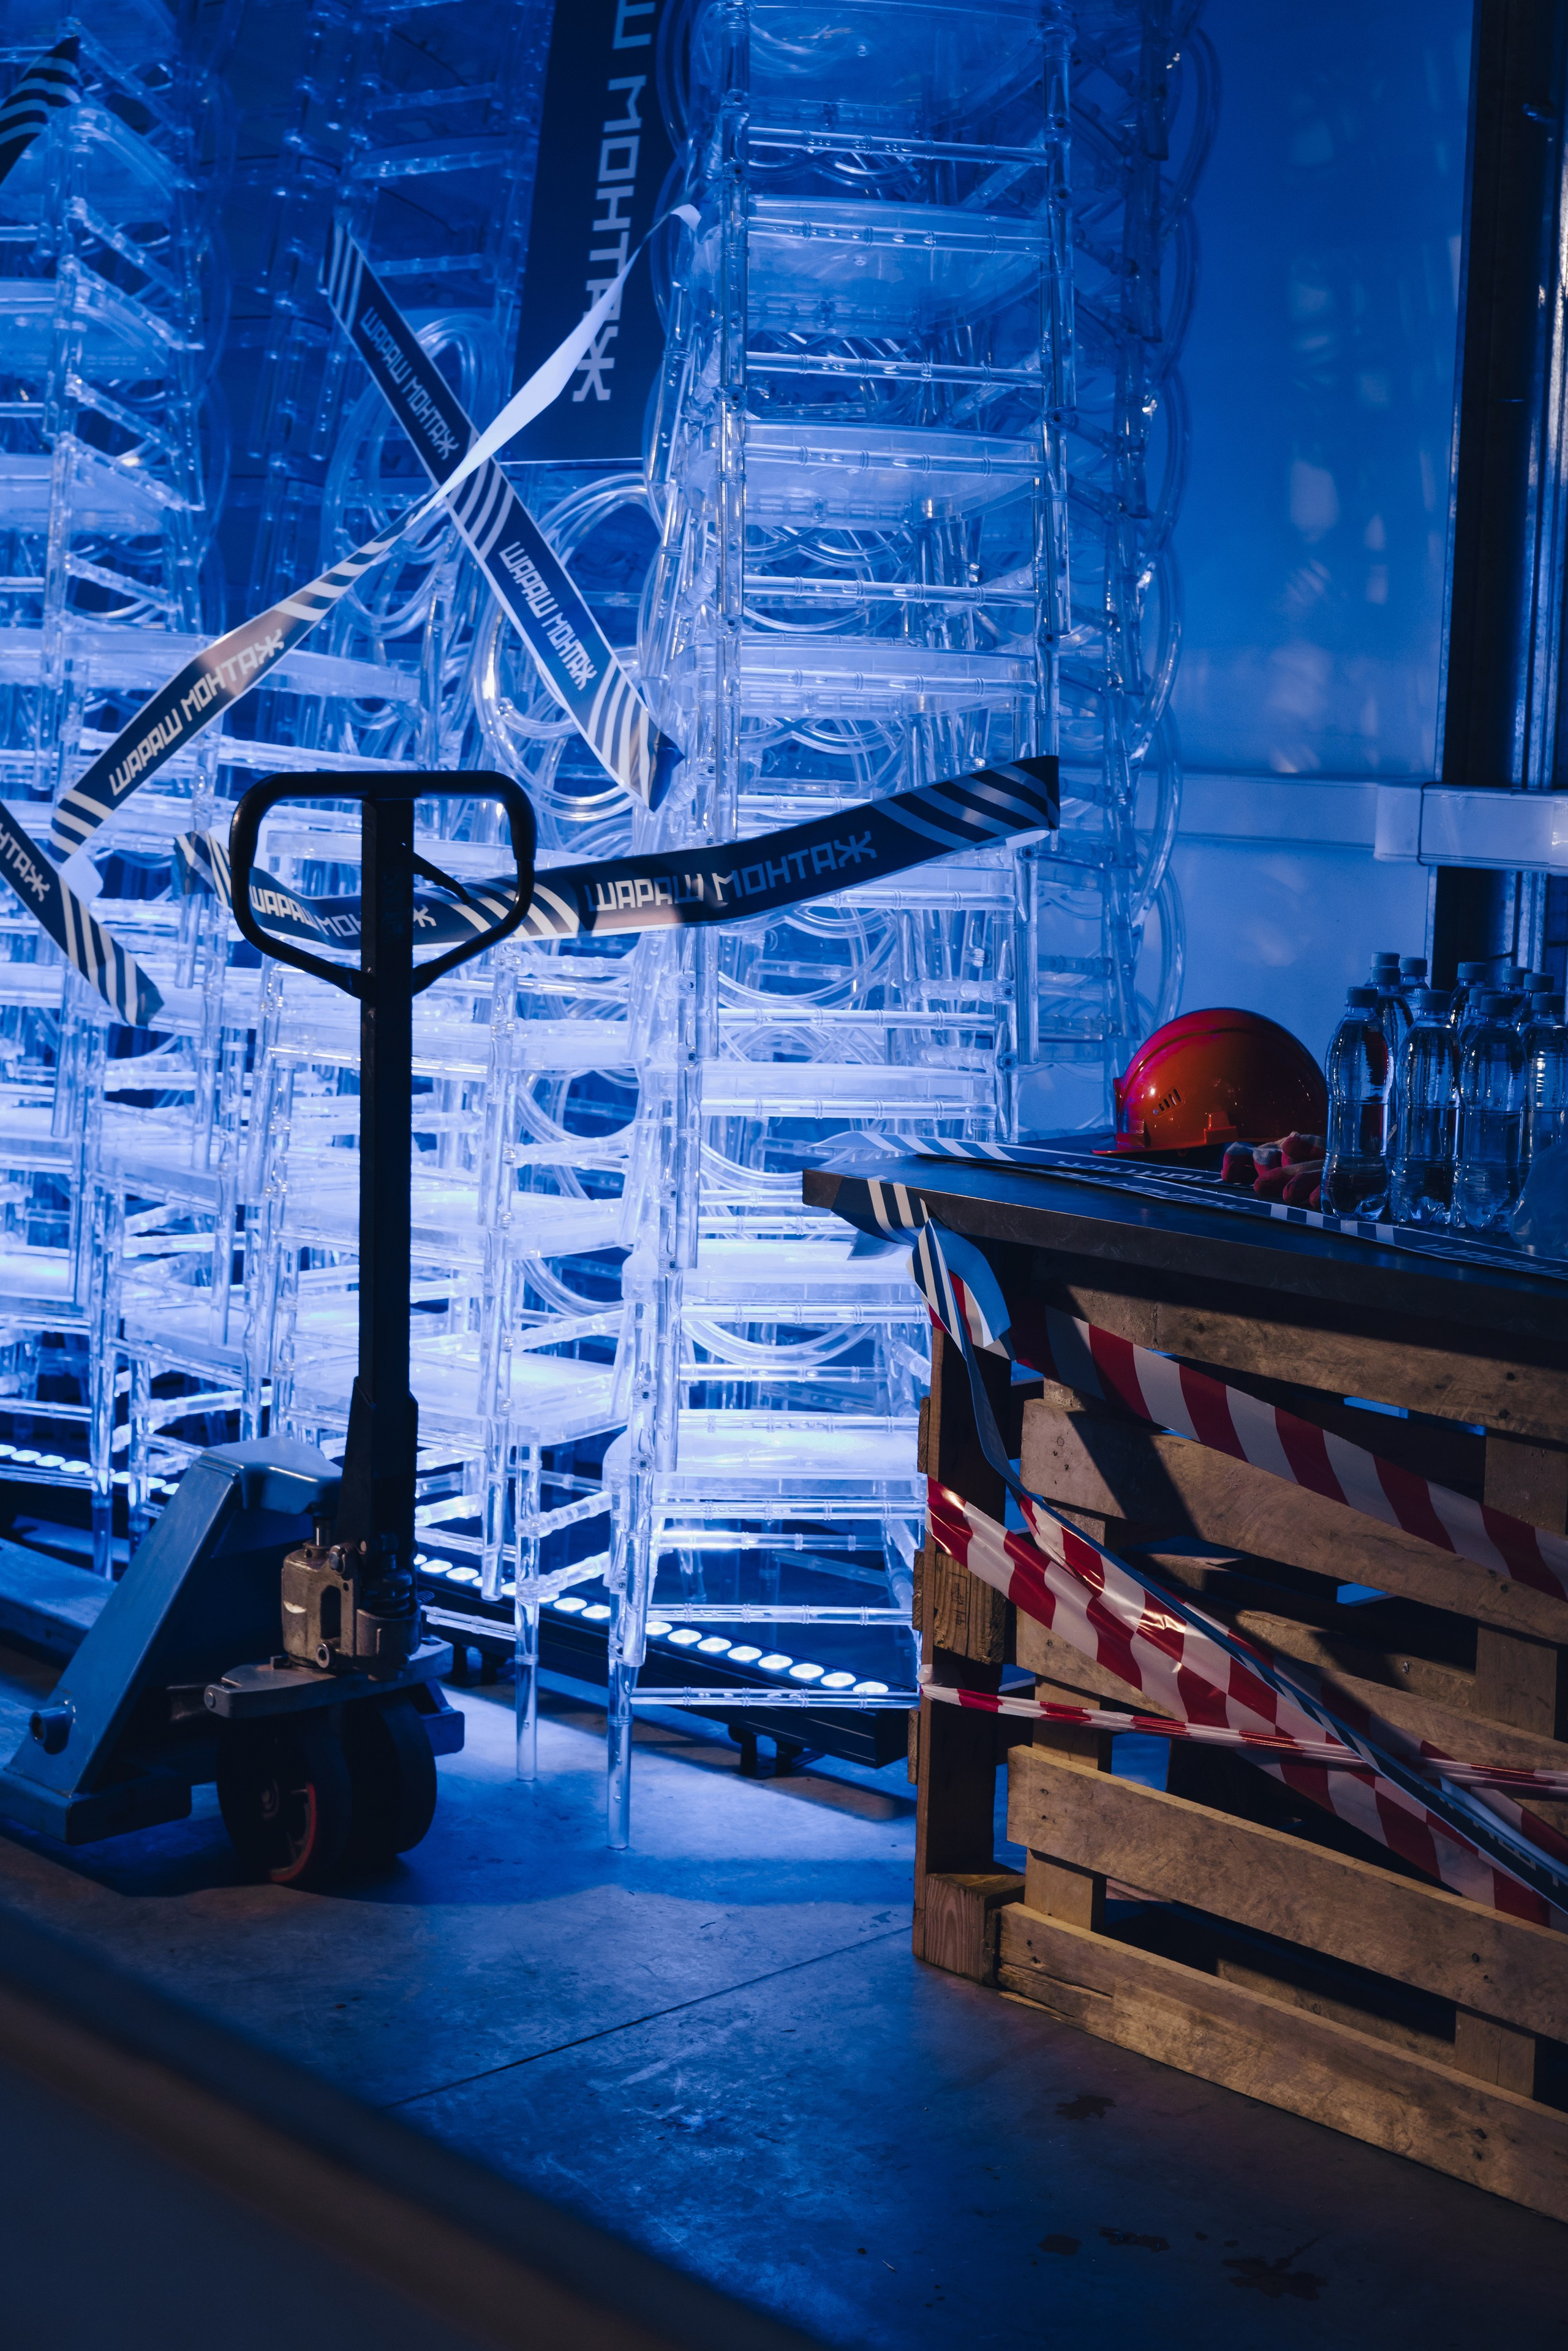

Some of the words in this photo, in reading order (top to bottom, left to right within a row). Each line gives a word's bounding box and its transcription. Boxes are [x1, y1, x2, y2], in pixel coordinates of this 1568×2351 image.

[360, 306, 412, 384] ШАРАШ
[401, 375, 459, 461] МОНТАЖ
[499, 542, 559, 619] ШАРАШ
[541, 612, 598, 691] МОНТАЖ
[109, 708, 183, 796] ШАРАШ
[180, 628, 285, 722] МОНТАЖ
[0, 822, 50, 902] НТАЖ
[249, 883, 321, 932] ШАРАШ
[584, 874, 704, 911] ШАРАШ
[712, 831, 878, 902] МОНТАЖ
